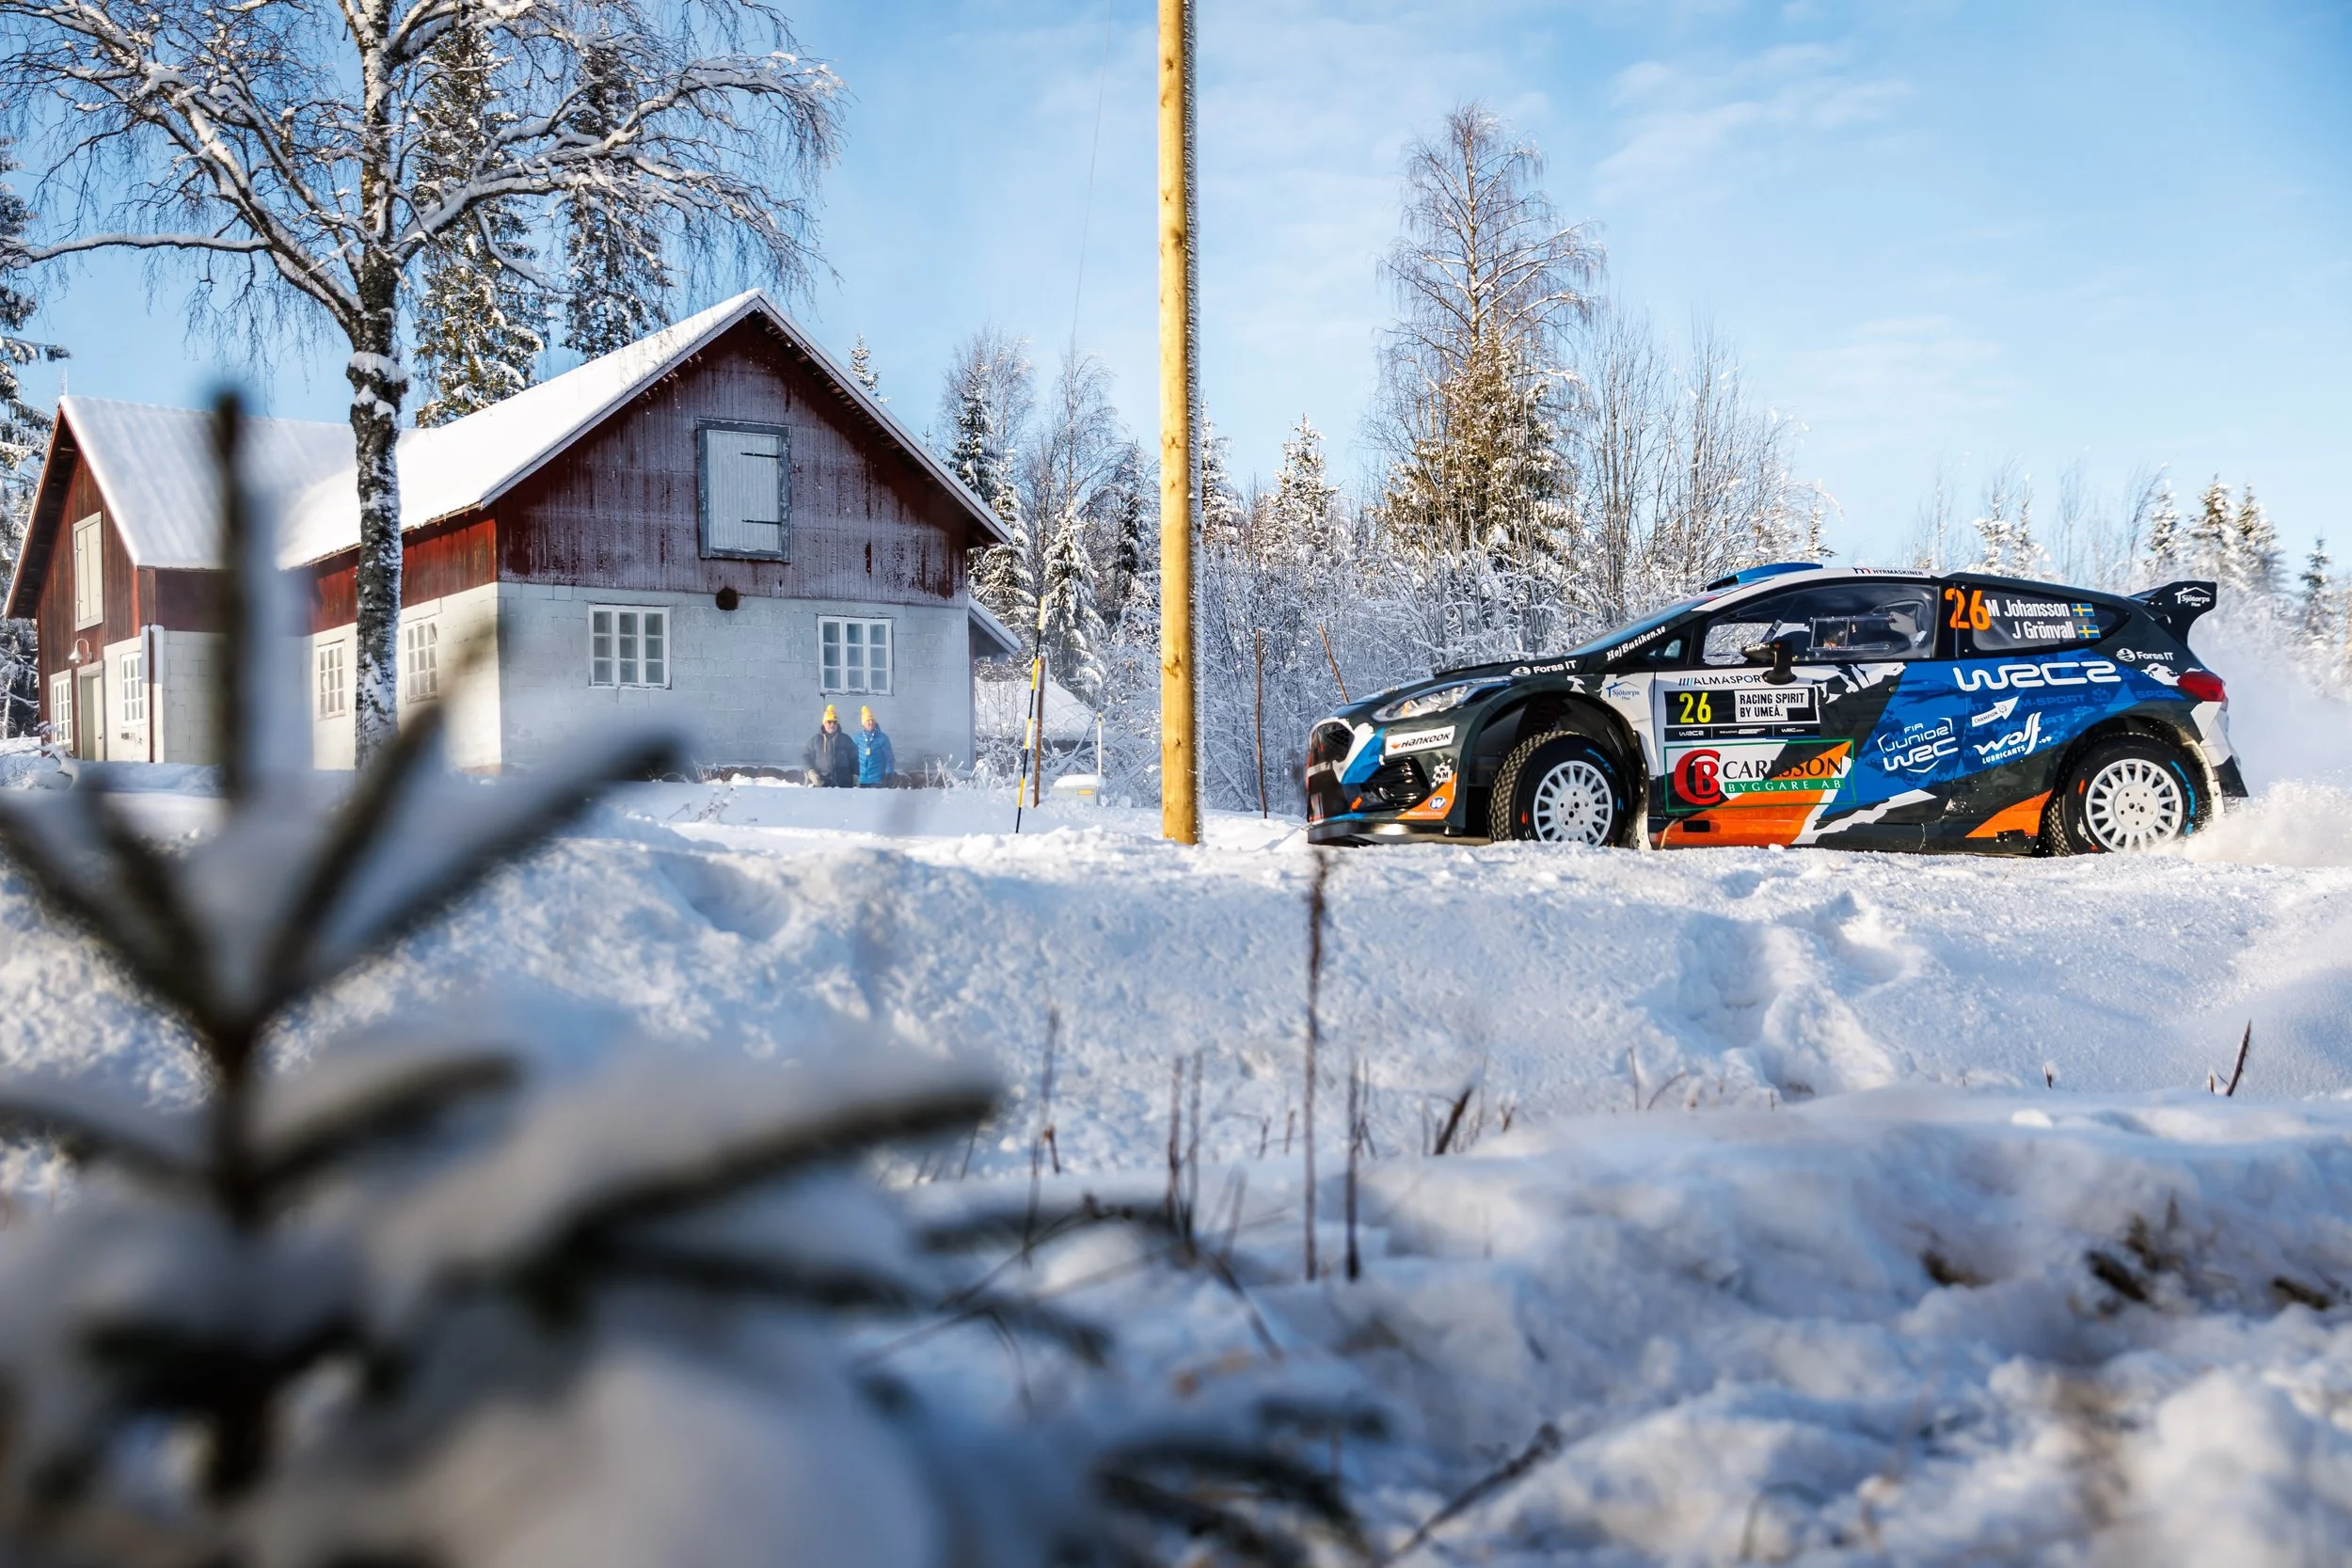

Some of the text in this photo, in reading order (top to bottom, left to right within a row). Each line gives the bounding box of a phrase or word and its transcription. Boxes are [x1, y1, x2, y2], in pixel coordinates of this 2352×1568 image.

[1944, 587, 1992, 631] 26
[1984, 599, 2070, 617] M Johansson
[2011, 621, 2076, 640] J Grönvall
[2136, 651, 2174, 660] Forss IT
[1533, 659, 1577, 674] Forss IT
[1693, 674, 1764, 686] ALMASPOR
[1952, 660, 2122, 692] WRC2
[1679, 692, 1711, 723] 26
[1740, 692, 1804, 705] RACING SPIRIT
[1740, 705, 1783, 718] BY UMEÅ.
[1903, 722, 1924, 734] FIA
[1884, 725, 1949, 752] JUNIOR
[1883, 736, 1959, 771] WRC
[1982, 745, 2026, 765] LUBRICANTS
[1728, 780, 1841, 792] BYGGARE AB
